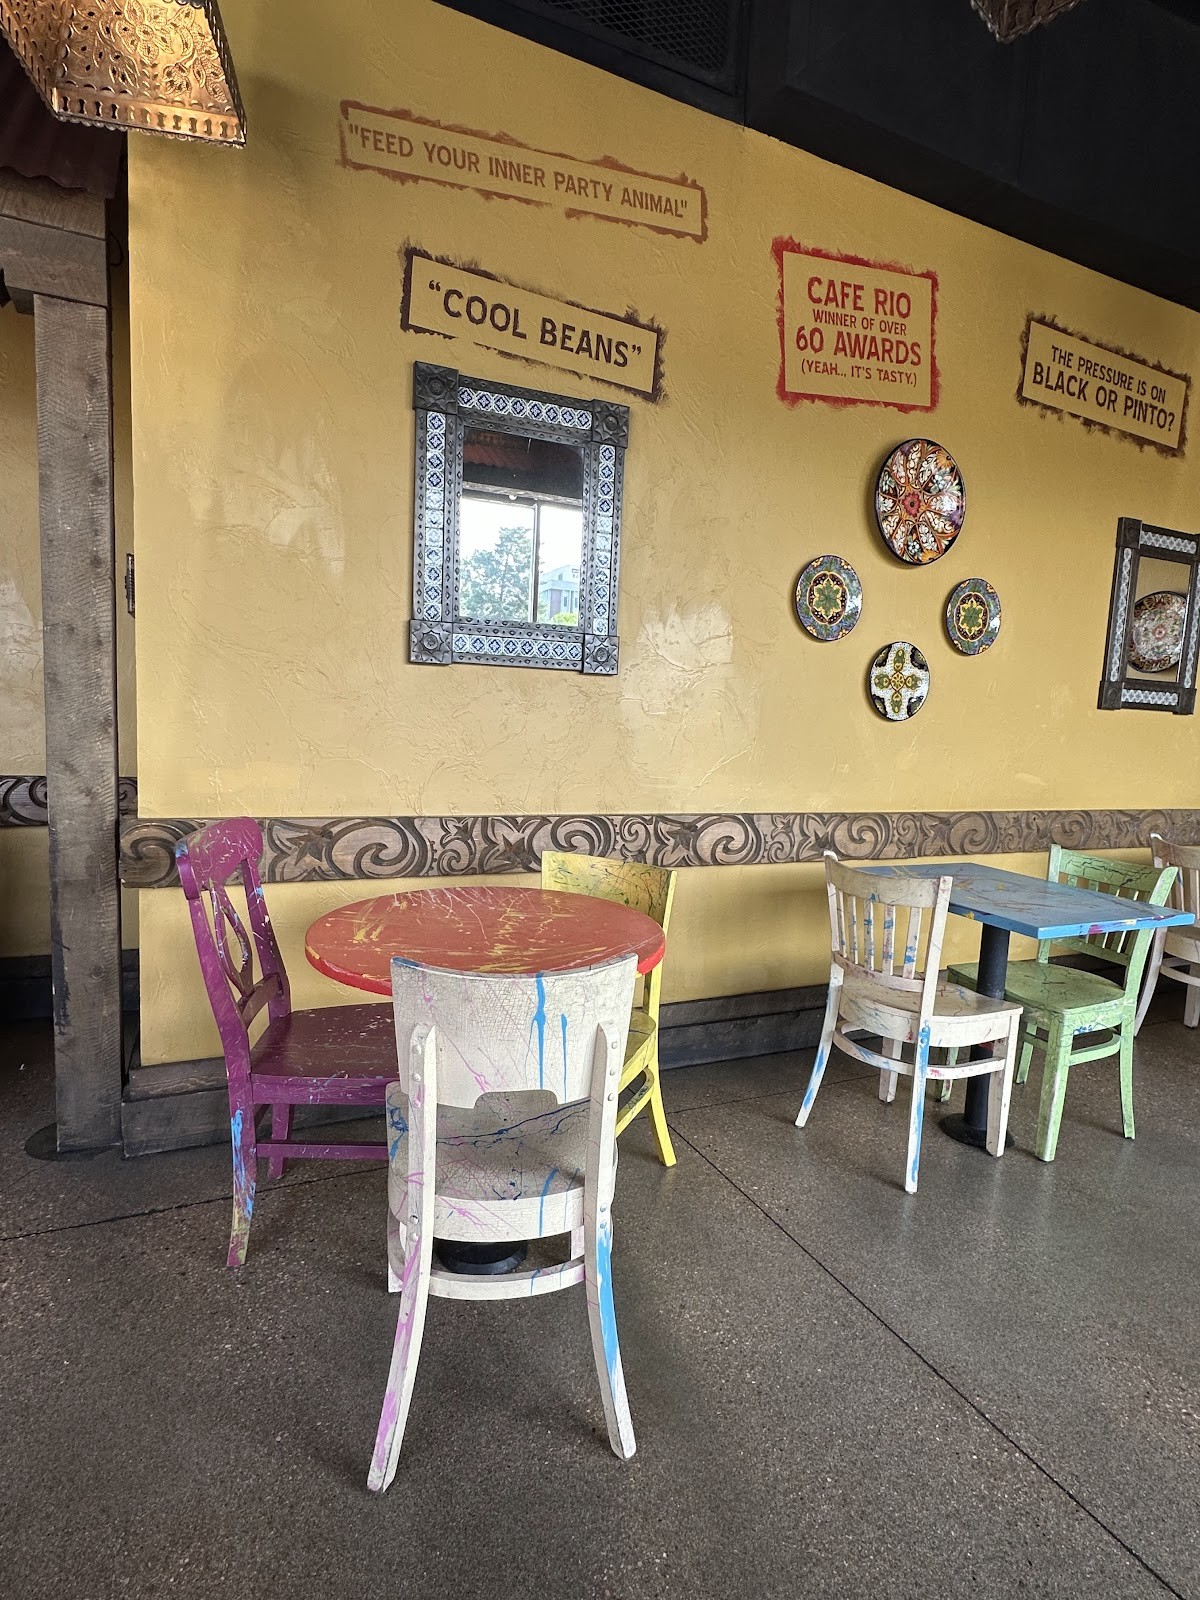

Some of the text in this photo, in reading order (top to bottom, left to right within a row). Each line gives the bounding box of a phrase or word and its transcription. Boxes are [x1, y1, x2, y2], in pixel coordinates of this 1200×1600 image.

[349, 124, 688, 218] "FEED YOUR INNER PARTY ANIMAL"
[807, 276, 911, 319] CAFE RIO
[812, 308, 907, 336] WINNER OF OVER
[796, 325, 921, 366] 60 AWARDS
[851, 365, 872, 380] IT'S
[1051, 345, 1166, 404] THE PRESSURE IS ON
[1032, 361, 1175, 432] BLACK OR PINTO?
